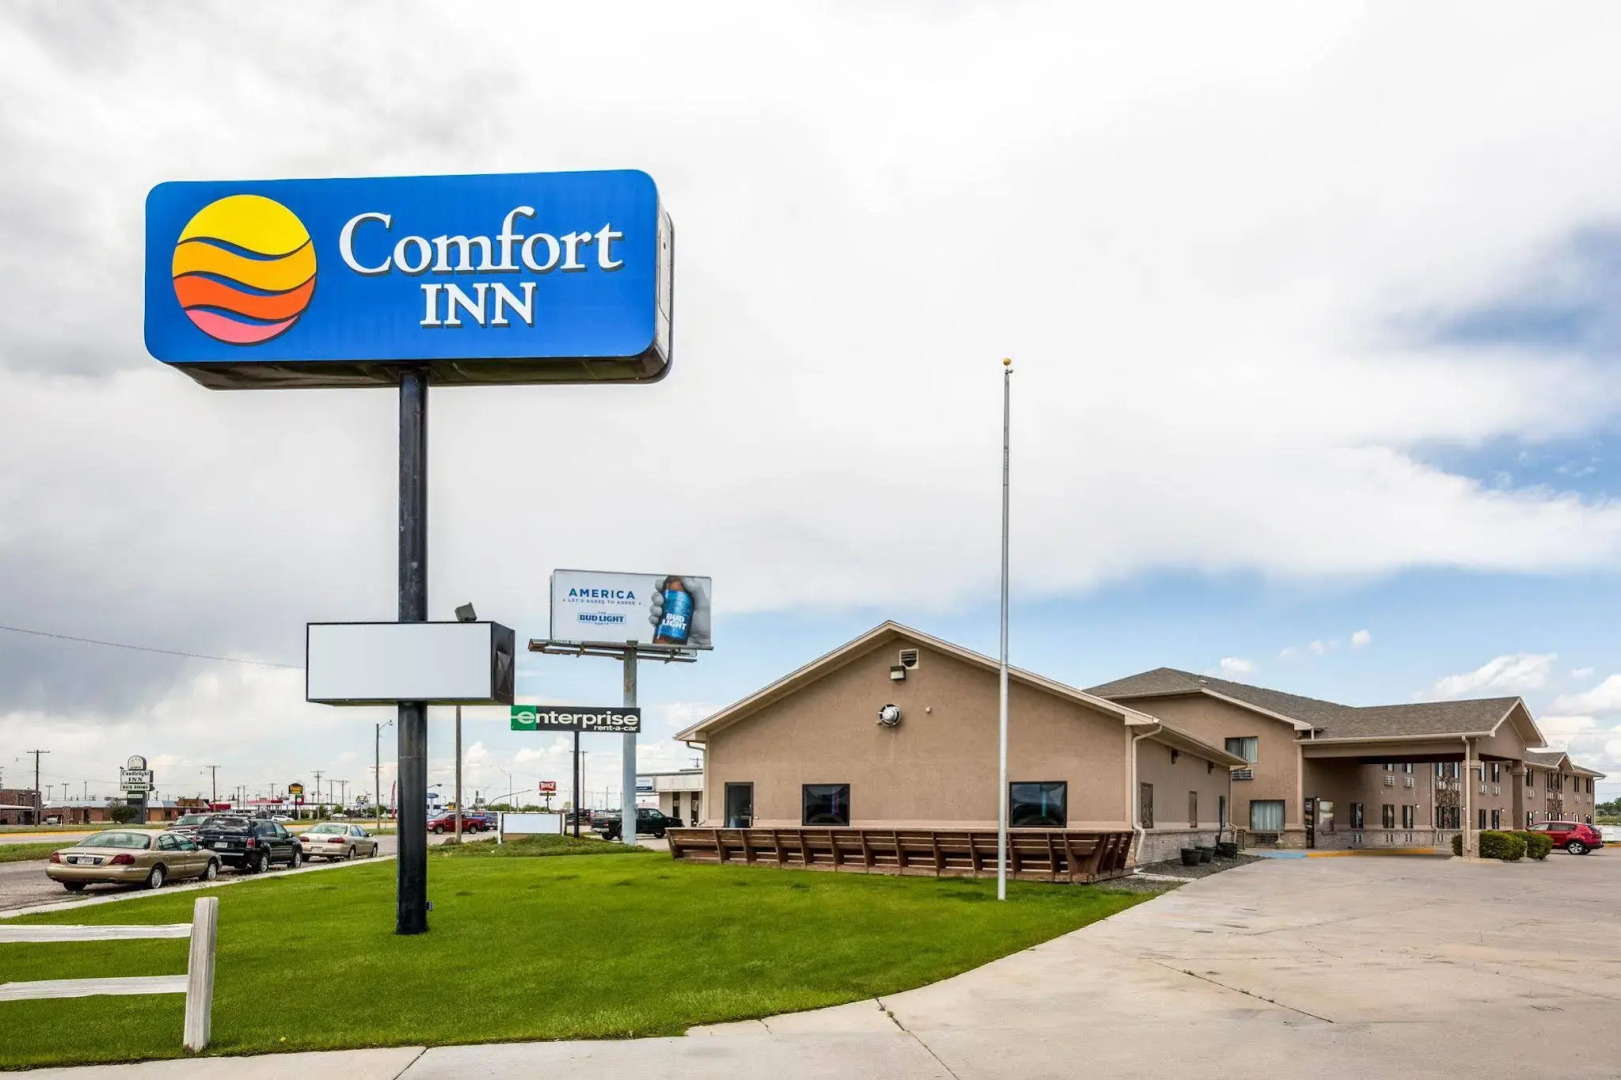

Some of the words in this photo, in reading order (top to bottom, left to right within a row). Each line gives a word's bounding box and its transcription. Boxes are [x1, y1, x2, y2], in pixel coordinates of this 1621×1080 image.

[339, 206, 624, 275] Comfort
[420, 282, 538, 328] INN
[568, 588, 635, 600] AMERICA
[579, 614, 598, 622] BUD
[599, 615, 624, 623] LIGHT
[666, 613, 685, 623] BUD
[662, 619, 687, 630] LIGHT
[512, 711, 639, 728] enterprise
